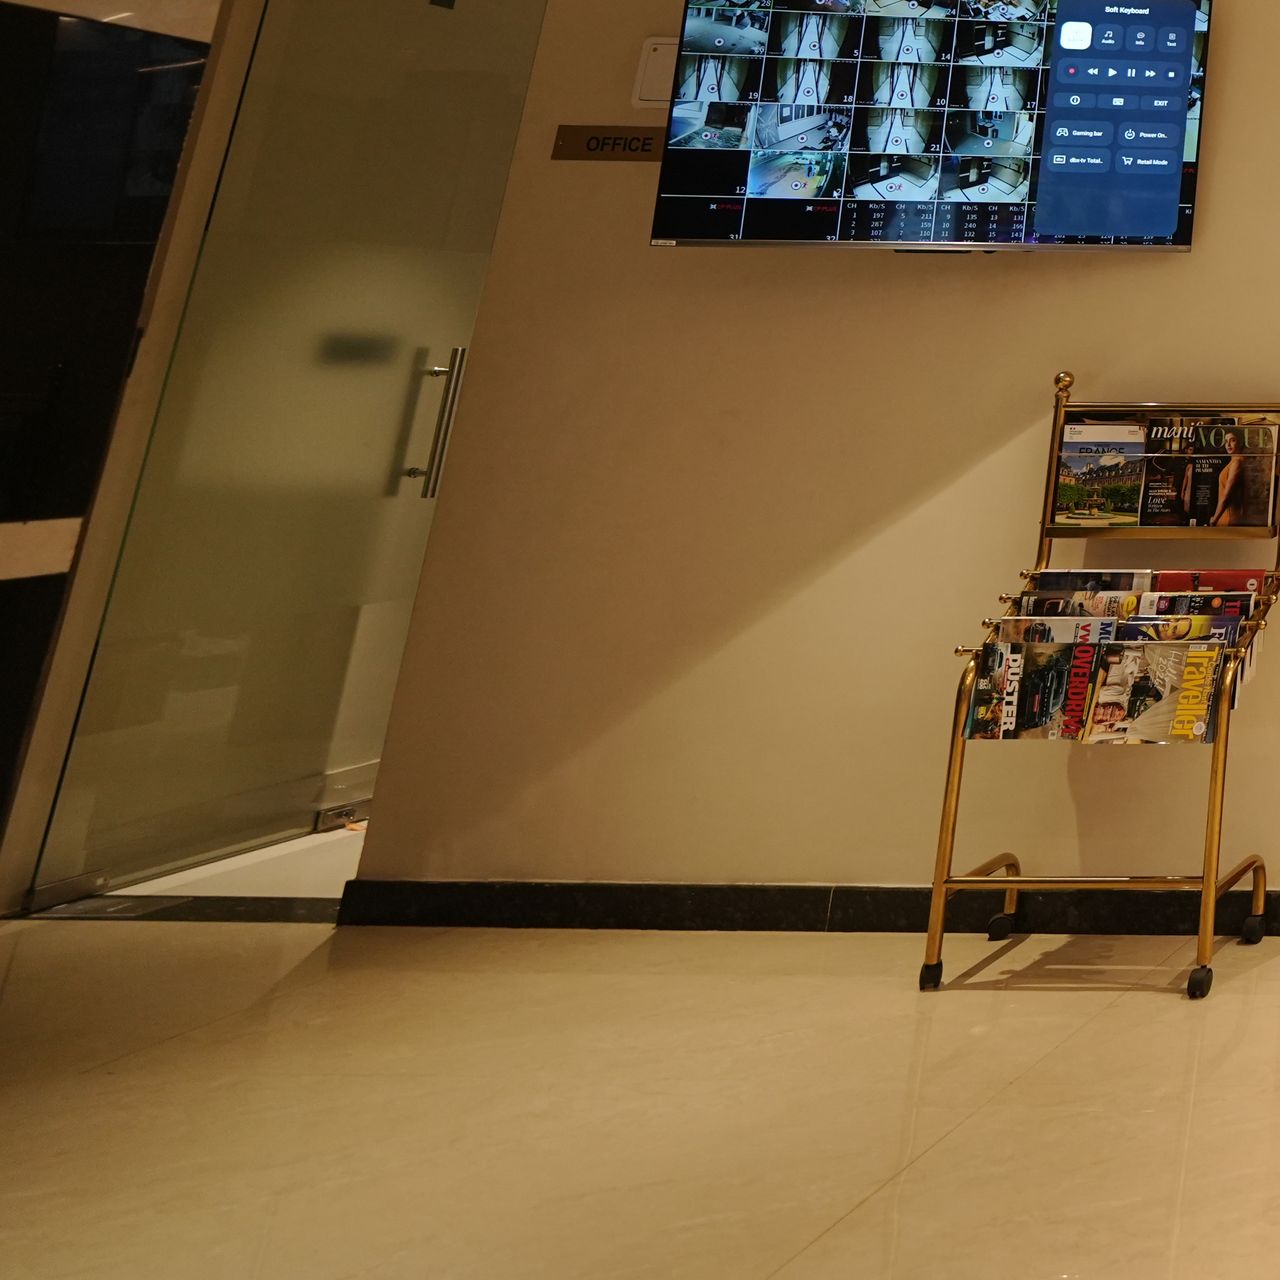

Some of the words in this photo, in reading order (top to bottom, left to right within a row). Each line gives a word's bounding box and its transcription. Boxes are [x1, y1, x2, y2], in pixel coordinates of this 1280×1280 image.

[1104, 6, 1118, 14] Soft
[1119, 6, 1150, 15] Keyboard
[853, 49, 859, 57] 5
[941, 53, 950, 61] 14
[843, 95, 854, 103] 18
[936, 98, 946, 106] 10
[1026, 101, 1037, 109] 17
[1072, 130, 1093, 138] Gaming
[586, 136, 653, 152] OFFICE
[930, 143, 941, 151] 21
[1198, 427, 1273, 448] VOUE
[1079, 447, 1126, 457] FRANCE
[1148, 496, 1167, 504] Love
[1003, 653, 1021, 731] DUSTER
[1061, 645, 1096, 738] OVERDRIVE
[1172, 646, 1220, 739] Traveller
